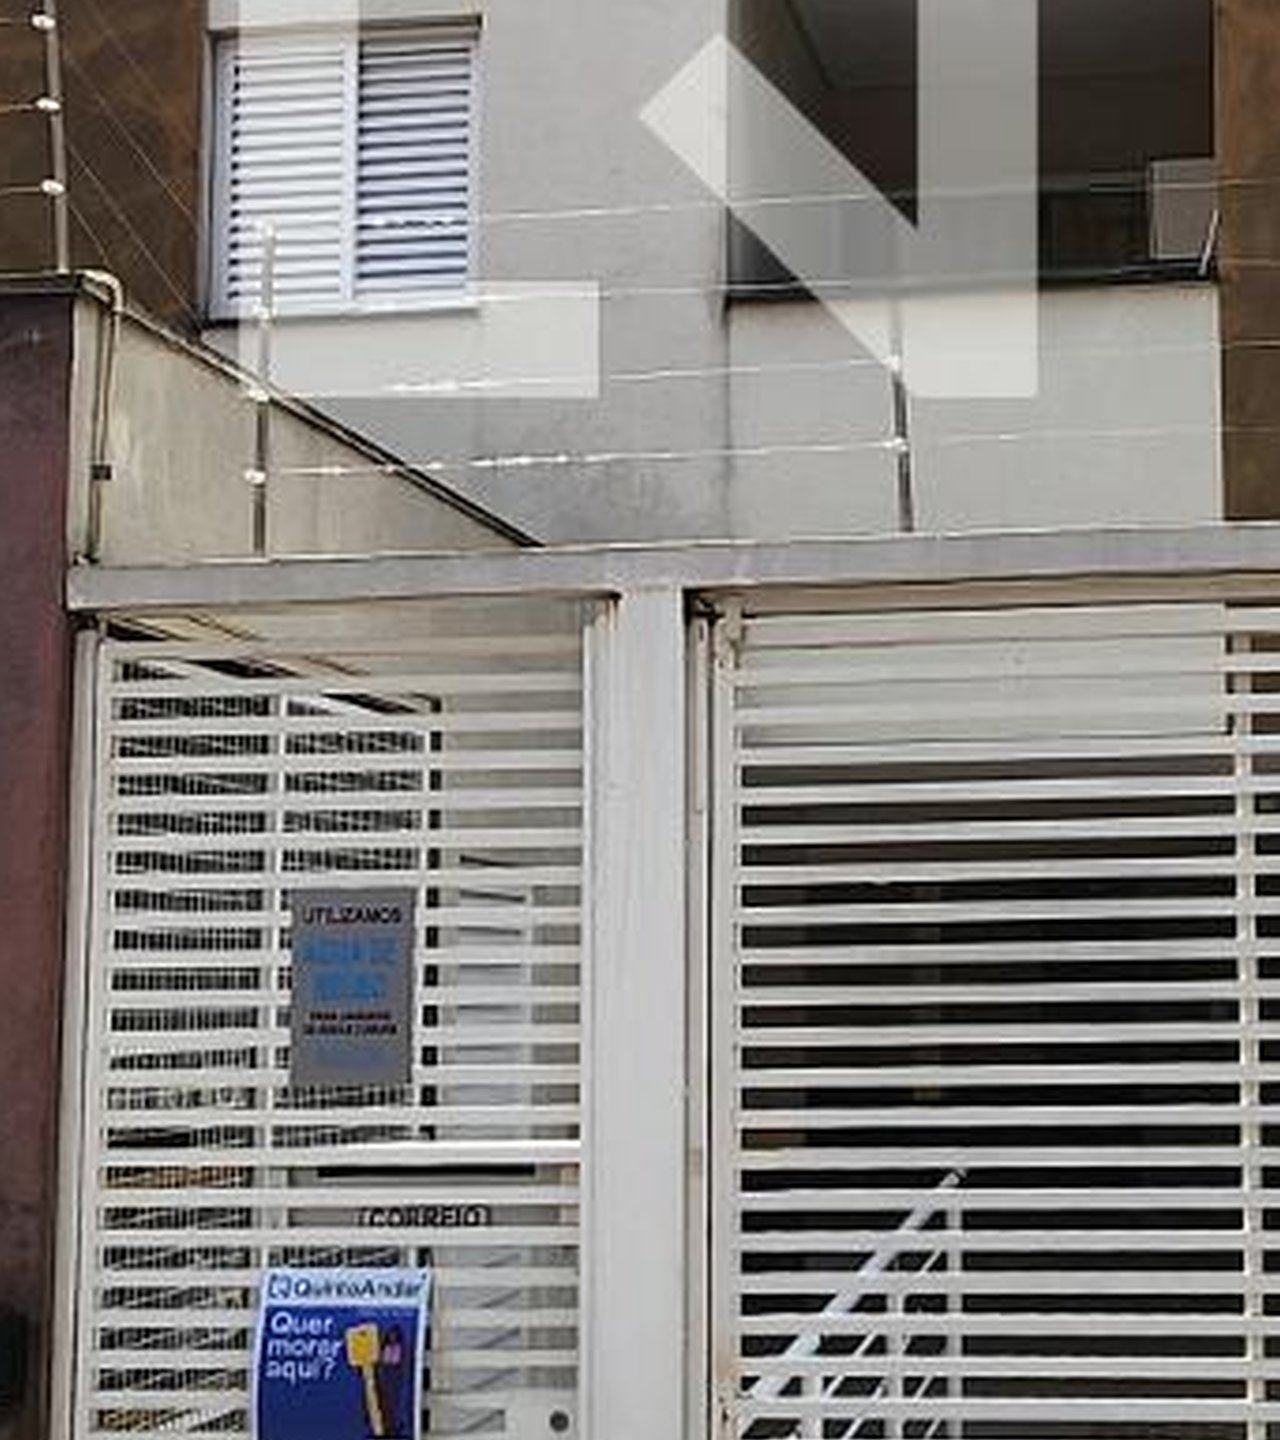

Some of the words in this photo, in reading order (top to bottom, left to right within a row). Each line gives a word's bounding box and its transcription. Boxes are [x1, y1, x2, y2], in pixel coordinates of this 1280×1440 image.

[304, 906, 401, 924] UTILIZAMOS
[370, 1203, 483, 1228] CORREIO
[271, 1310, 334, 1335] Quer
[267, 1337, 343, 1357] morar
[265, 1357, 337, 1386] aqui?
